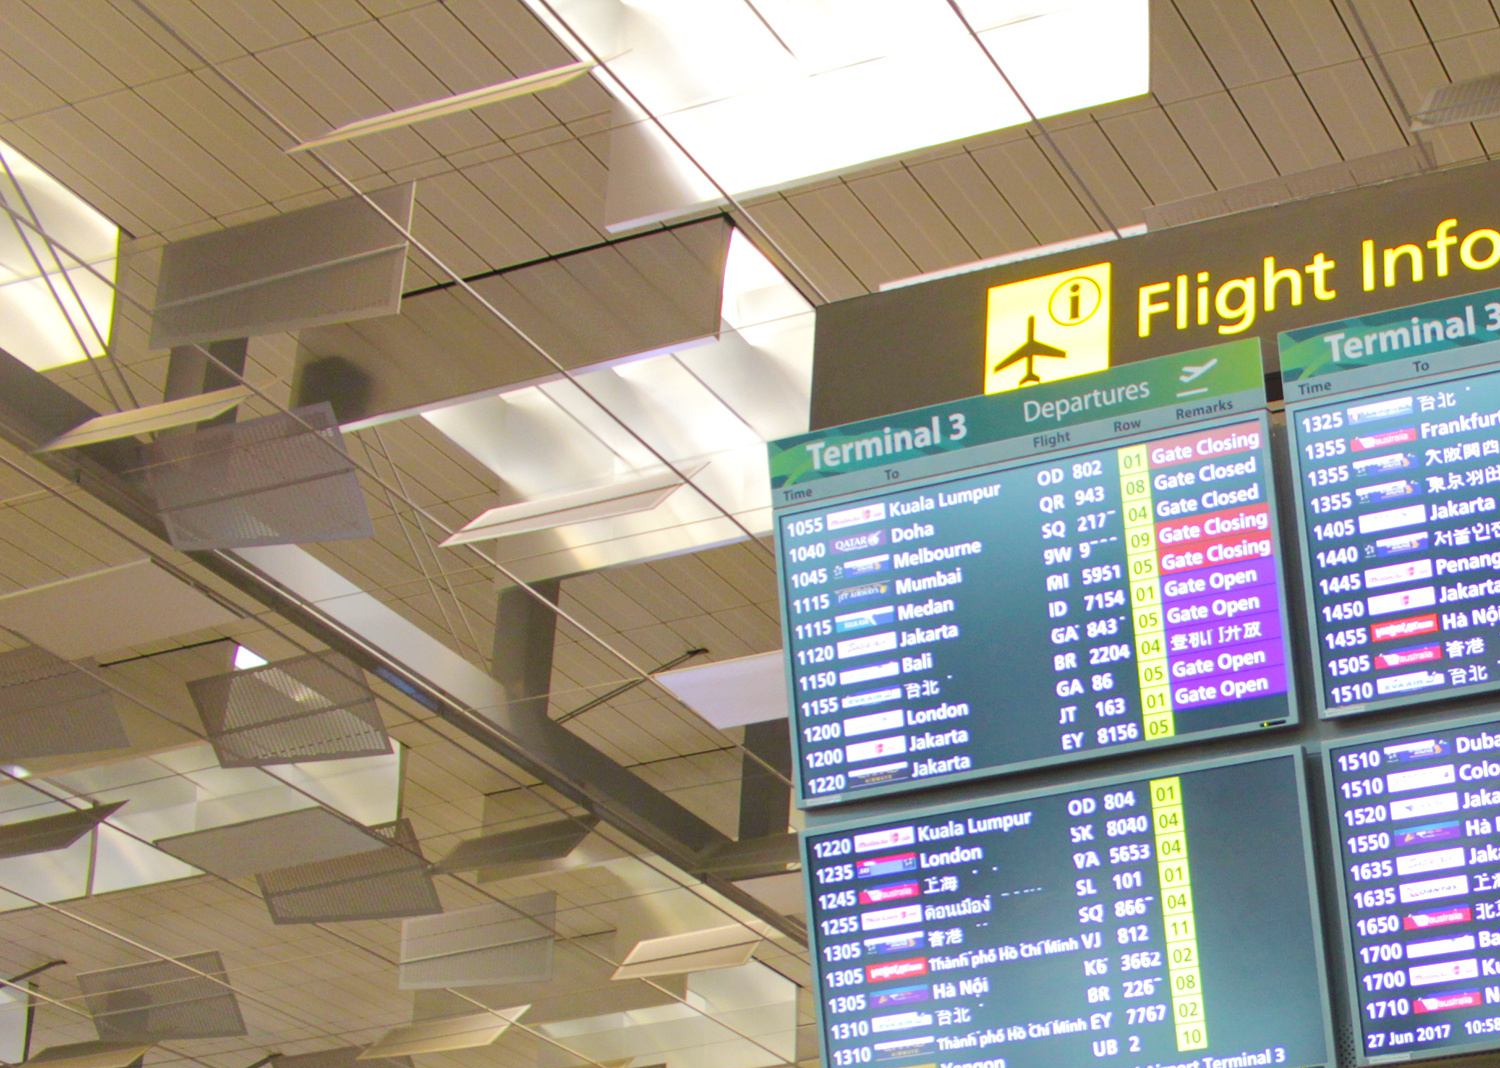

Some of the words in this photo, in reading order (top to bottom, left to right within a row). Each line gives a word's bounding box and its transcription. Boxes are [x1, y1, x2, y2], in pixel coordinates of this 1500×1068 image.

[1138, 255, 1336, 337] Flight
[1323, 305, 1475, 362] Terminal
[1297, 381, 1331, 395] Time
[1412, 360, 1429, 372] To
[783, 488, 812, 501] Time
[884, 468, 899, 480] To
[1032, 431, 1070, 448] Flight
[1113, 419, 1141, 432] Row
[1176, 399, 1233, 420] Remarks
[805, 415, 940, 469] Terminal
[948, 412, 967, 440] 3
[1023, 381, 1149, 422] Departures
[1305, 437, 1346, 459] 1355
[787, 516, 823, 537] 1055
[889, 495, 934, 517] Kuala
[938, 483, 1001, 507] Lumpur
[1036, 467, 1064, 486] OD
[1072, 459, 1102, 479] 802
[1123, 453, 1141, 469] 01
[1151, 446, 1192, 464] Gate
[1196, 433, 1259, 455] Closing
[789, 542, 825, 562] 1040
[835, 535, 867, 552] QATAR
[890, 522, 934, 543] Doha
[1039, 493, 1064, 513] QR
[1074, 485, 1104, 505] 943
[1126, 479, 1145, 495] 08
[1153, 471, 1195, 490] Gate
[1198, 456, 1256, 481] Closed
[1313, 518, 1355, 540] 1405
[1429, 496, 1496, 521] Jakarta
[893, 540, 982, 568] Melbourne
[1156, 498, 1197, 516] Gate
[1201, 482, 1259, 508] Closed
[895, 567, 962, 595] Mumbai
[1159, 525, 1200, 543] Gate
[1204, 512, 1268, 535] Closing
[897, 598, 954, 620] Medan
[1161, 551, 1203, 570] Gate
[1206, 539, 1271, 561] Closing
[900, 624, 958, 647] Jakarta
[1164, 578, 1206, 597] Gate
[1209, 569, 1257, 590] Open
[1319, 573, 1361, 594] 1445
[901, 652, 932, 673] Bali
[1166, 605, 1208, 623] Gate
[1211, 596, 1260, 617] Open
[906, 702, 968, 725] London
[1172, 659, 1214, 677] Gate
[1217, 650, 1266, 670] Open
[807, 773, 845, 795] 1220
[911, 755, 970, 777] Jakarta
[1061, 731, 1083, 750] EY
[1097, 722, 1137, 744] 8156
[1338, 750, 1380, 771] 1510
[813, 838, 851, 858] 1220
[917, 820, 964, 842] Kuala
[967, 811, 1031, 833] Lumpur
[1068, 797, 1096, 816] OD
[1103, 790, 1135, 810] 804
[1156, 785, 1174, 801] 01
[1362, 970, 1405, 991] 1700
[1092, 1038, 1118, 1057] UB
[1128, 1035, 1140, 1052] 2
[1183, 1028, 1201, 1044] 10
[1274, 1047, 1285, 1062] 3
